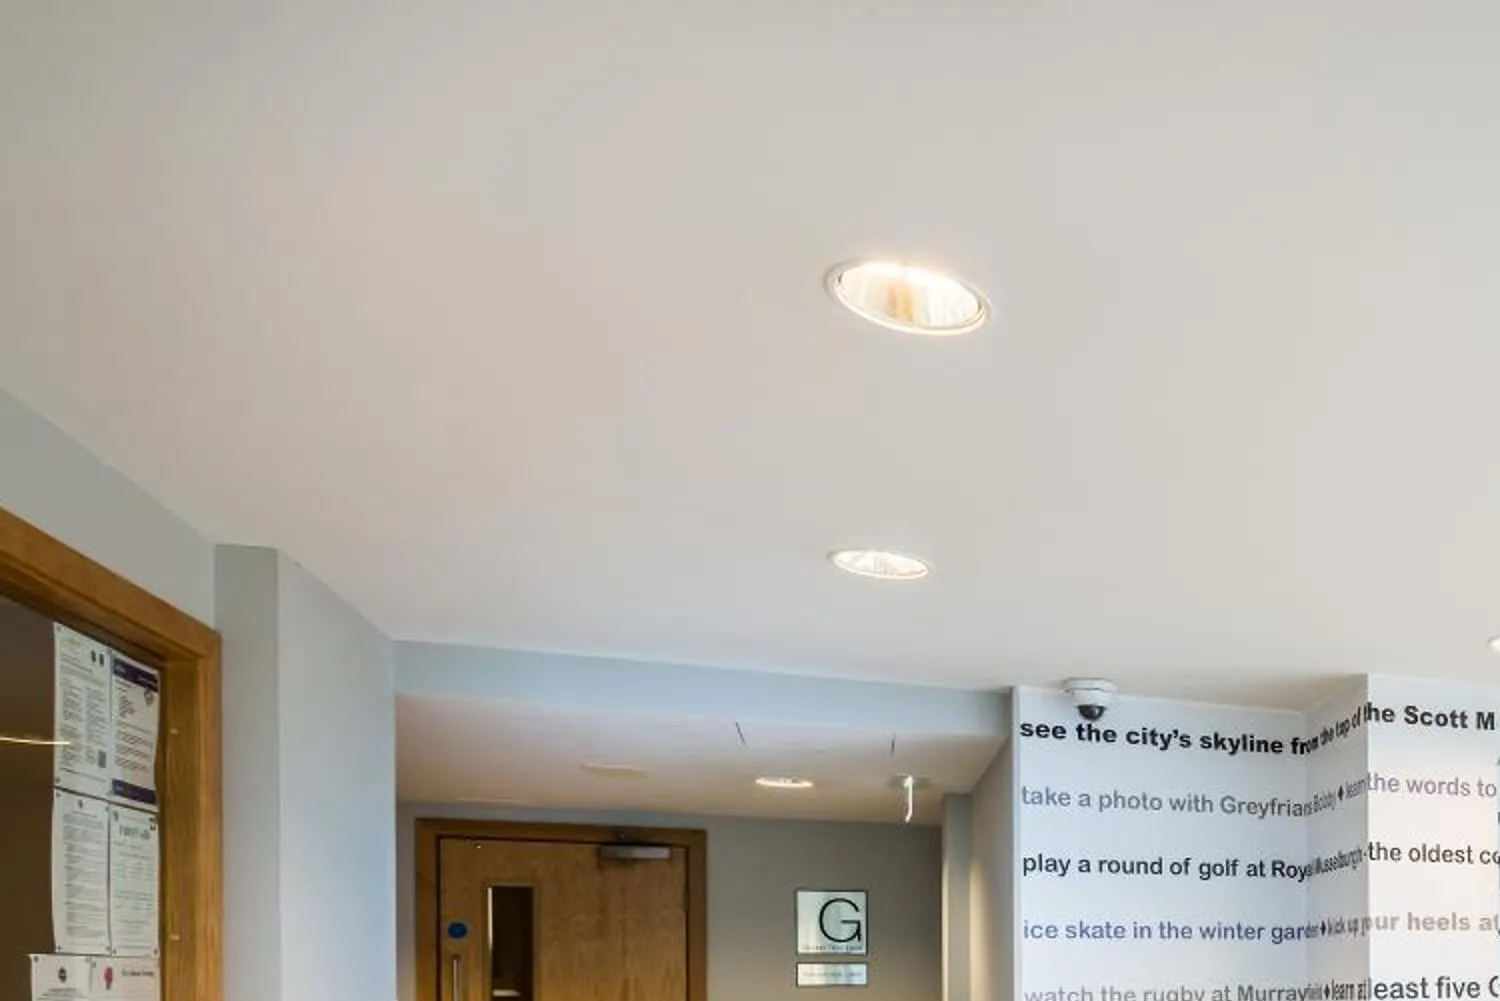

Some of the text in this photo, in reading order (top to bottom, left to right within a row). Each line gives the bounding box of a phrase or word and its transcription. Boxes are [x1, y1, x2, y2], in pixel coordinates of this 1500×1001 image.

[1020, 722, 1067, 740] see
[1076, 723, 1117, 743] the
[1126, 727, 1191, 751] city's
[1199, 733, 1284, 755] skyline
[1291, 735, 1318, 755] from
[1364, 702, 1395, 723] the
[1404, 706, 1469, 729] Scott
[1476, 711, 1496, 731] M
[1366, 773, 1400, 793] the
[1407, 777, 1472, 798] words
[1477, 775, 1497, 798] to
[1022, 785, 1071, 808] take
[1078, 791, 1092, 807] a
[1099, 790, 1163, 813] photo
[1169, 791, 1214, 813] with
[1367, 841, 1473, 864] the oldest
[1023, 852, 1071, 878] play
[1078, 857, 1092, 873] a
[1098, 855, 1163, 876] round
[1169, 857, 1191, 876] of
[1199, 858, 1239, 880] golf
[1246, 860, 1267, 878] at
[819, 898, 861, 942] G
[1023, 920, 1059, 940] ice
[1065, 920, 1126, 940] skate
[1133, 922, 1151, 940] in
[1159, 920, 1193, 940] the
[1200, 923, 1266, 941] winter
[1407, 912, 1472, 931] heels
[1368, 976, 1430, 1000] least
[1436, 975, 1482, 999] five
